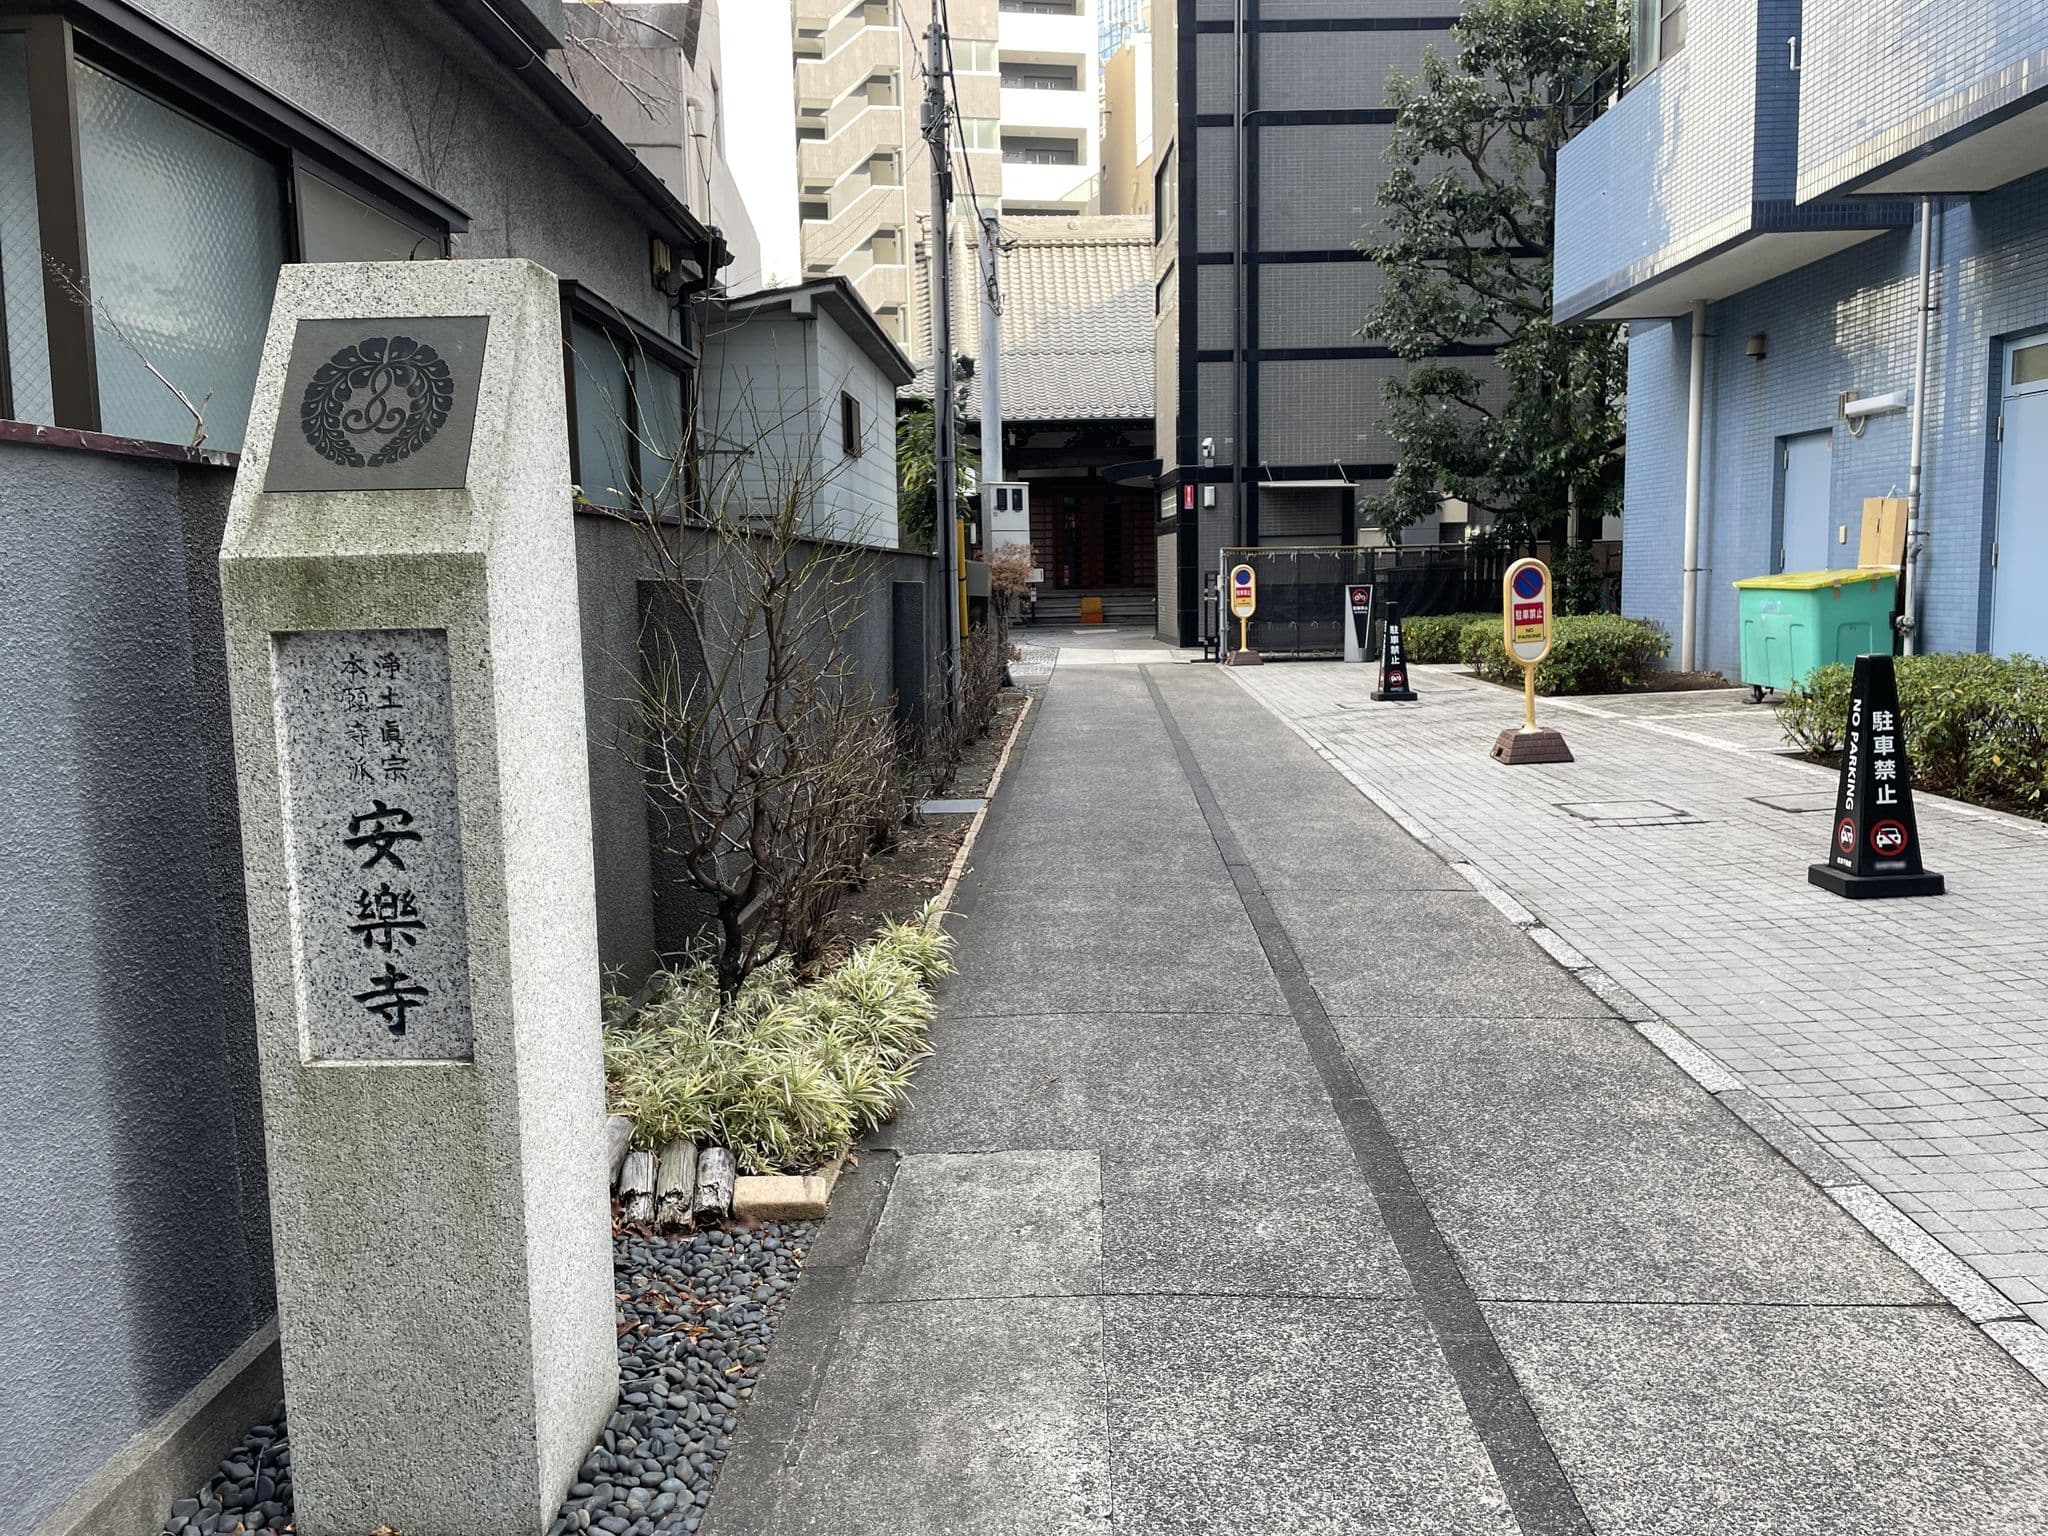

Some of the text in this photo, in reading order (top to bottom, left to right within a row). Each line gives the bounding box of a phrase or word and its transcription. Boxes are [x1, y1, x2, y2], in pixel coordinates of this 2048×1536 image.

[1846, 698, 1861, 810] NO PARKING
[1872, 710, 1898, 805] 駐車禁止
